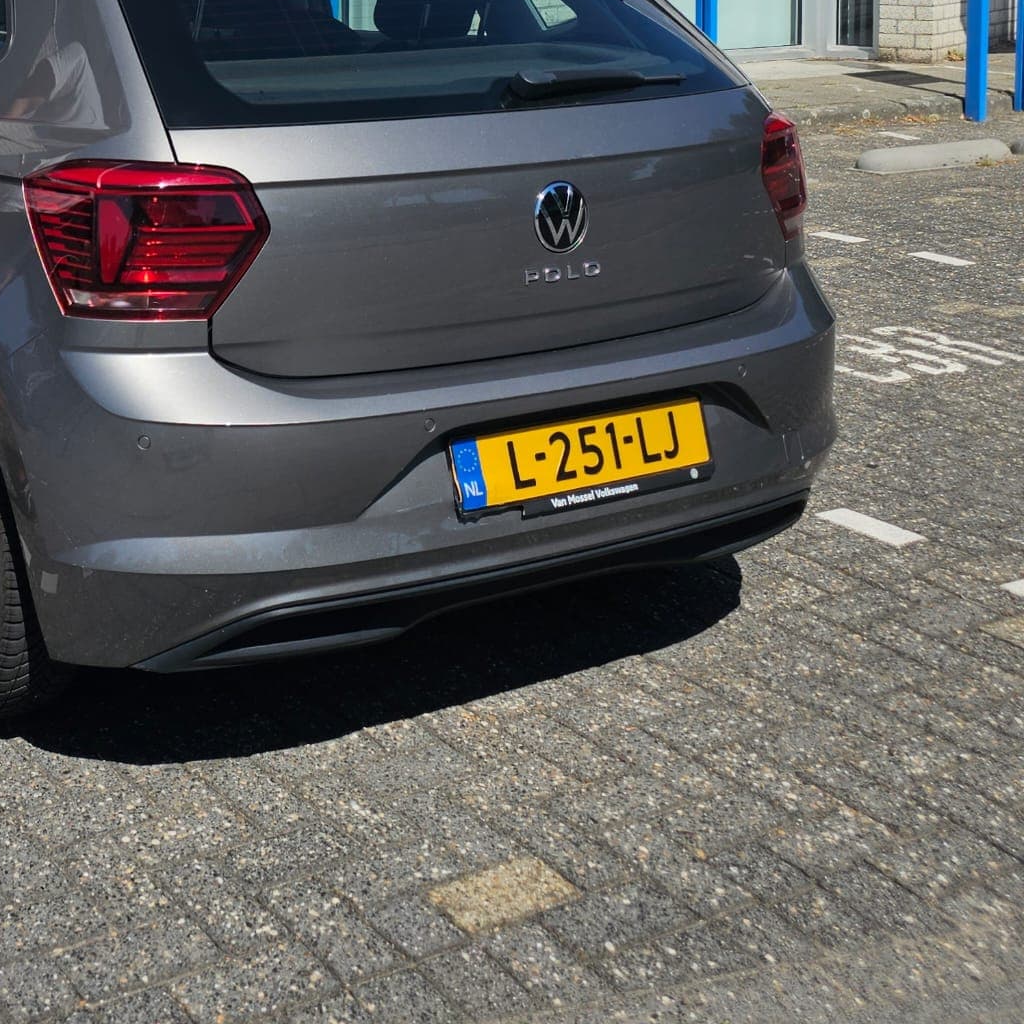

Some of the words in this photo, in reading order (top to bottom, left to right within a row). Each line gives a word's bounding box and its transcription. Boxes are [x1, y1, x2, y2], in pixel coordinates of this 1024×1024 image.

[524, 261, 601, 286] POLO
[507, 410, 680, 490] L-251-LJ
[463, 480, 484, 499] NL
[551, 497, 567, 509] Van
[567, 489, 595, 505] Mossel
[595, 483, 639, 498] Volkswagen
